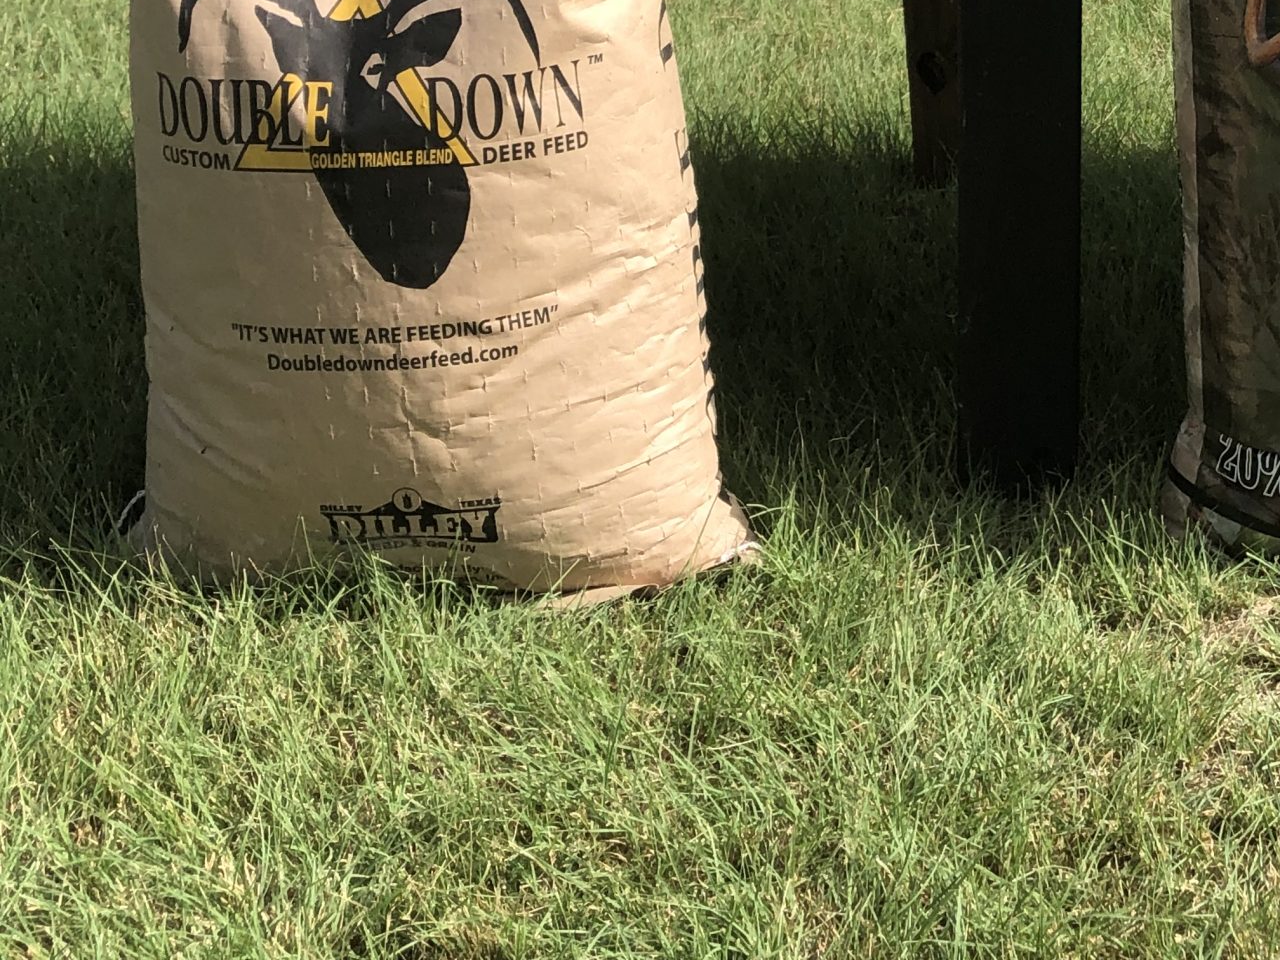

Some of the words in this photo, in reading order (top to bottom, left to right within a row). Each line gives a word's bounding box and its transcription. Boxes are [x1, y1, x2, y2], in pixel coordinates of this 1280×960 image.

[157, 71, 333, 147] DOUBLE
[426, 59, 585, 141] DOWN
[162, 145, 232, 171] CUSTOM
[311, 151, 357, 170] GOLDEN
[357, 149, 415, 168] TRIANGLE
[416, 148, 453, 166] BLEND
[482, 140, 538, 165] DEER
[543, 130, 589, 155] FEED
[271, 326, 326, 345] WHAT
[331, 327, 360, 345] WE
[364, 326, 402, 344] ARE
[406, 318, 493, 343] FEEDING
[267, 343, 519, 372] Doubledowndeerfeed.com
[460, 497, 502, 508] TEXAS
[329, 513, 494, 540] DILLEY
